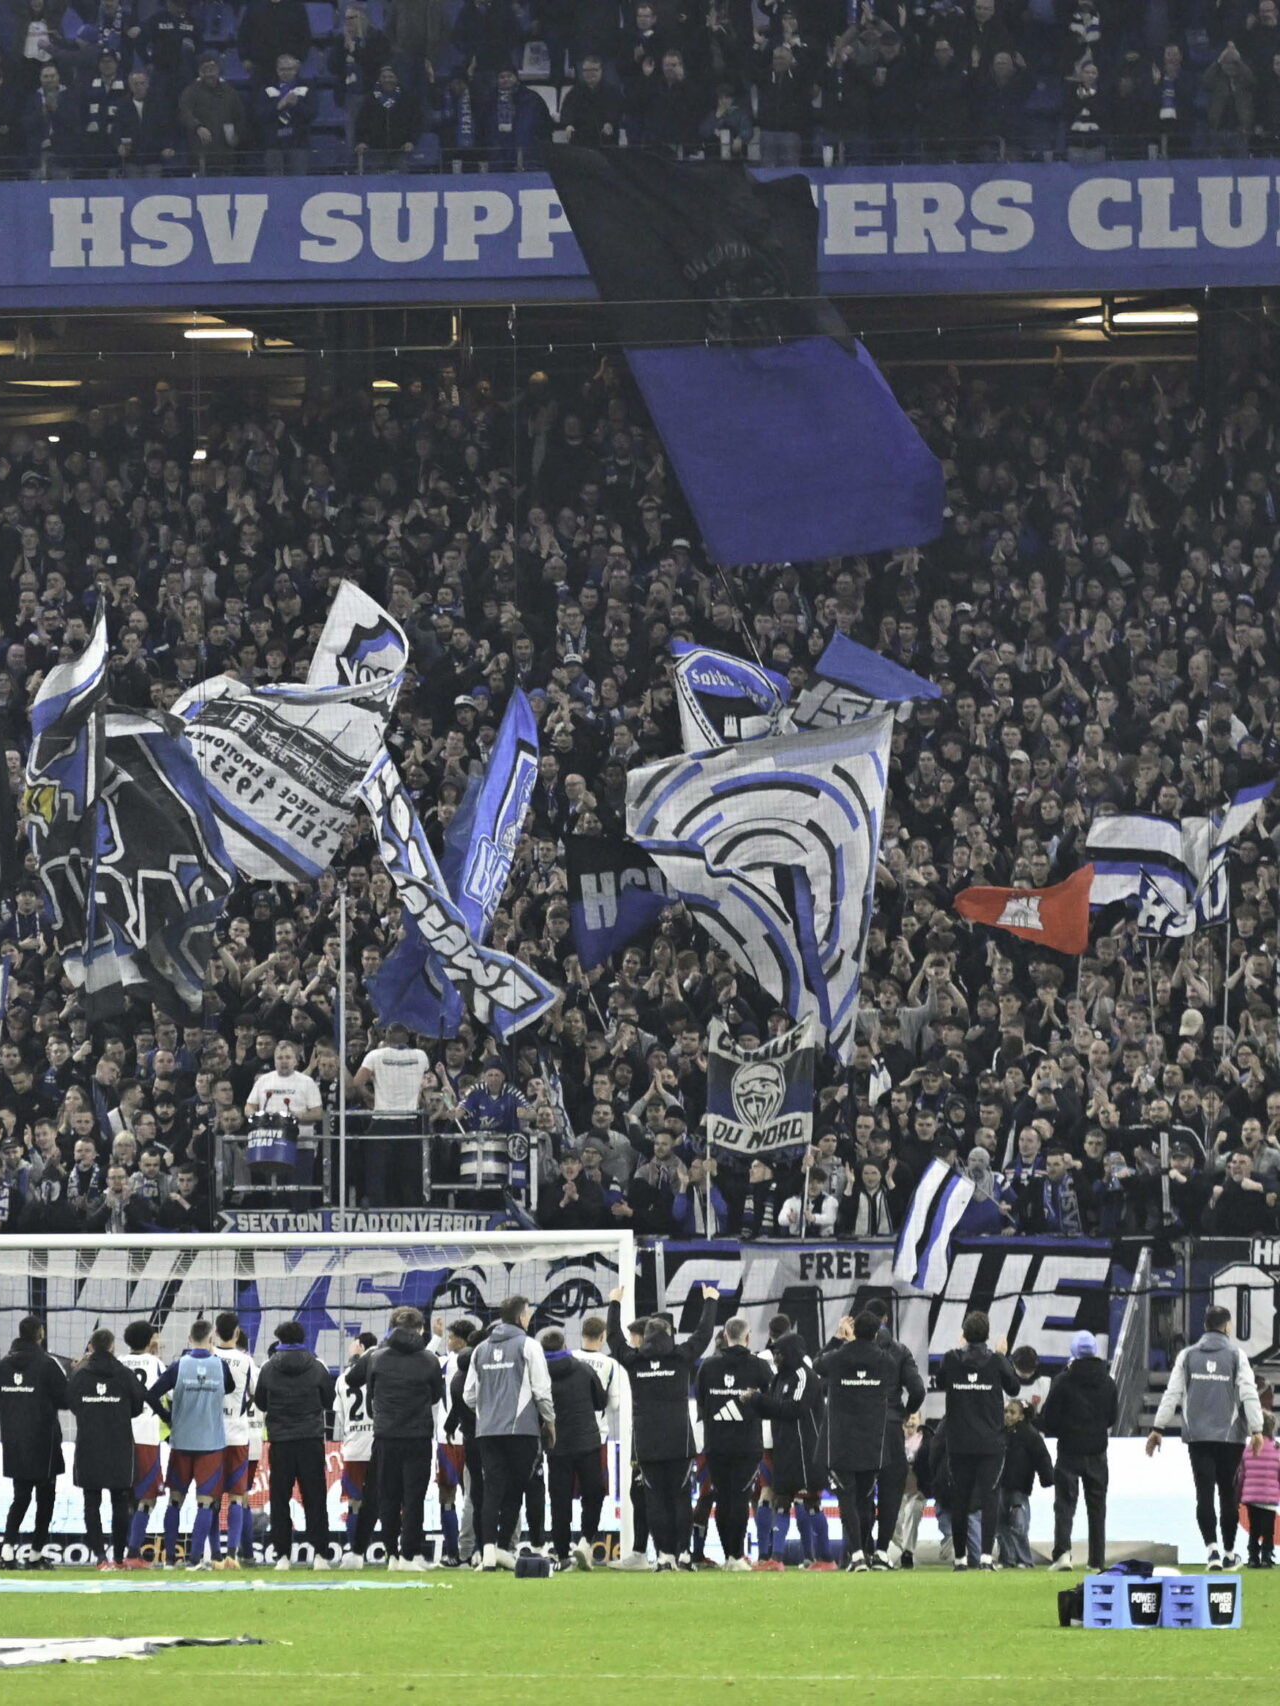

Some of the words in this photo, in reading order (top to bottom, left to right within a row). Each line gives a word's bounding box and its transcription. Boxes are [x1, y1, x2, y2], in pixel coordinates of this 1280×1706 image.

[49, 193, 268, 268] HSV
[1067, 175, 1280, 252] CLU
[713, 1120, 743, 1145] DU
[746, 1118, 803, 1149] NORD
[236, 1212, 323, 1233] SEKTION
[331, 1210, 491, 1233] STADIONVERBOT
[799, 1251, 872, 1282] FREE
[637, 1369, 676, 1378] HanseMerkur
[1191, 1372, 1231, 1383] HanseMerkur
[840, 1378, 882, 1386] HanseMerkur
[952, 1382, 993, 1392] HanseMerkur
[1, 1385, 35, 1394] HanseMerkur
[82, 1395, 121, 1404] HanseMerkur
[1130, 1591, 1157, 1604] POWER
[1209, 1591, 1233, 1604] POWER
